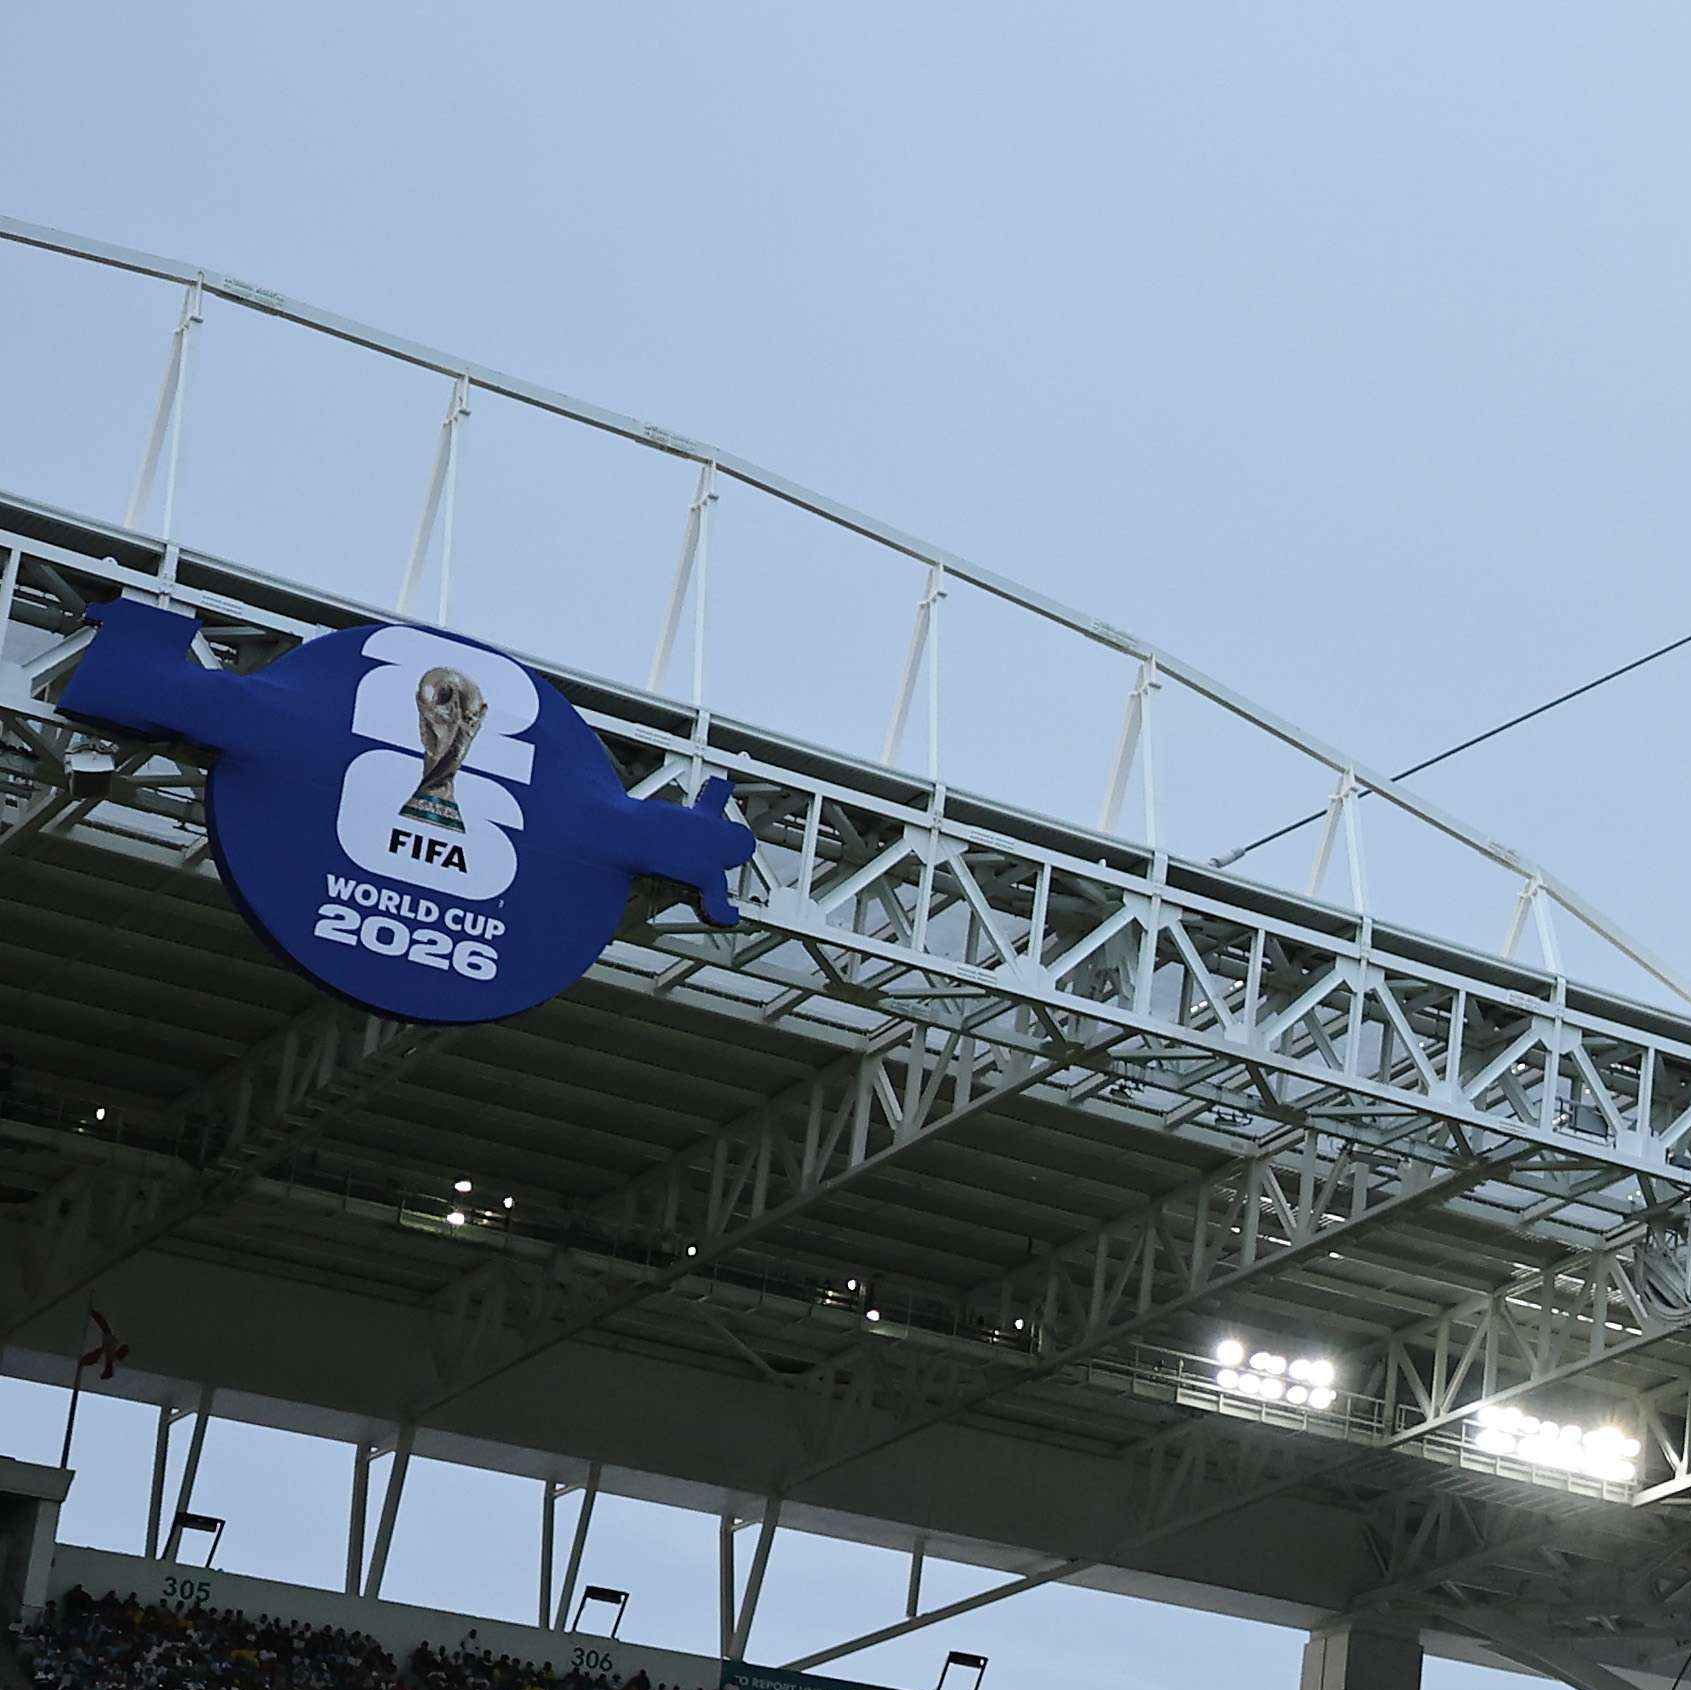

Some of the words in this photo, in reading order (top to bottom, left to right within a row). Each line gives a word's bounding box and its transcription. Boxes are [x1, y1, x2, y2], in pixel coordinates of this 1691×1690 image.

[389, 828, 467, 873] FIFA
[326, 873, 440, 923] WORLD
[444, 907, 506, 940] CUP
[314, 903, 499, 982] 2026
[163, 1576, 210, 1602] 305
[571, 1647, 612, 1672] 306
